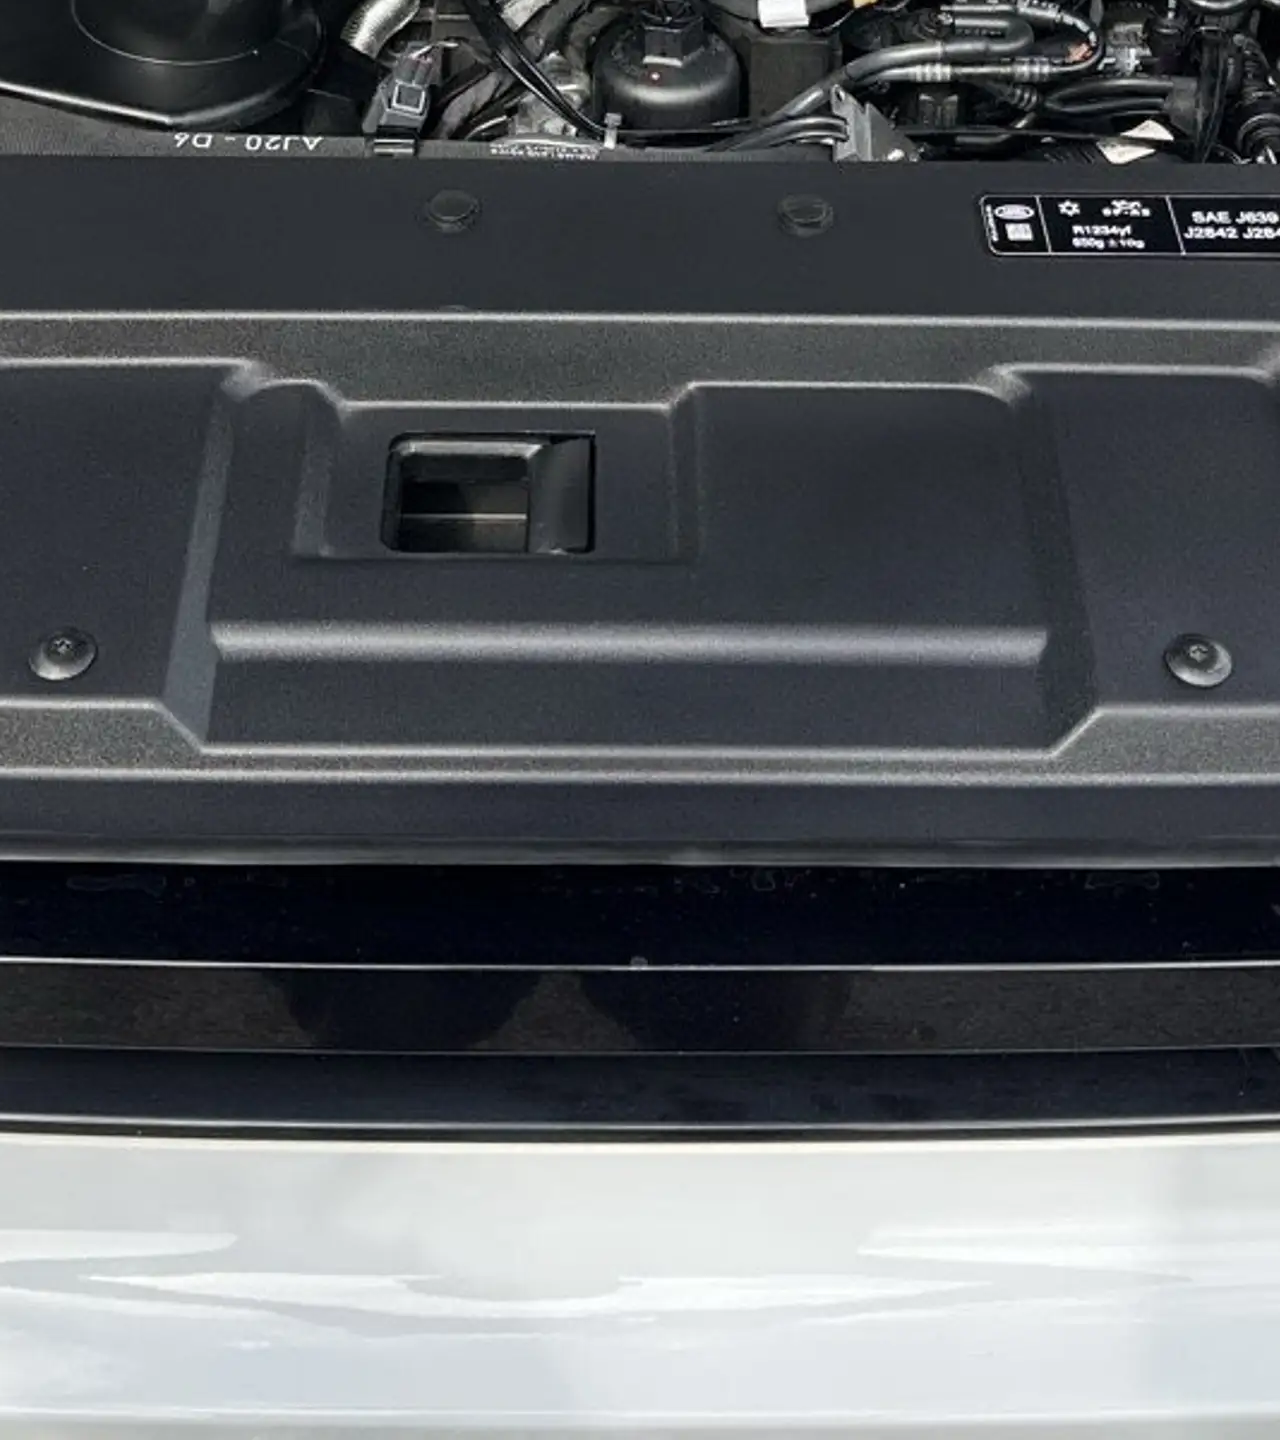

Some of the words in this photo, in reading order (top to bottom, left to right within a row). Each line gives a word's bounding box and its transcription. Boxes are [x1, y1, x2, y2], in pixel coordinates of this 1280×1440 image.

[173, 132, 213, 148] D6
[244, 134, 324, 152] AJ20
[1192, 211, 1231, 224] SAE
[1072, 225, 1131, 237] R1234yf
